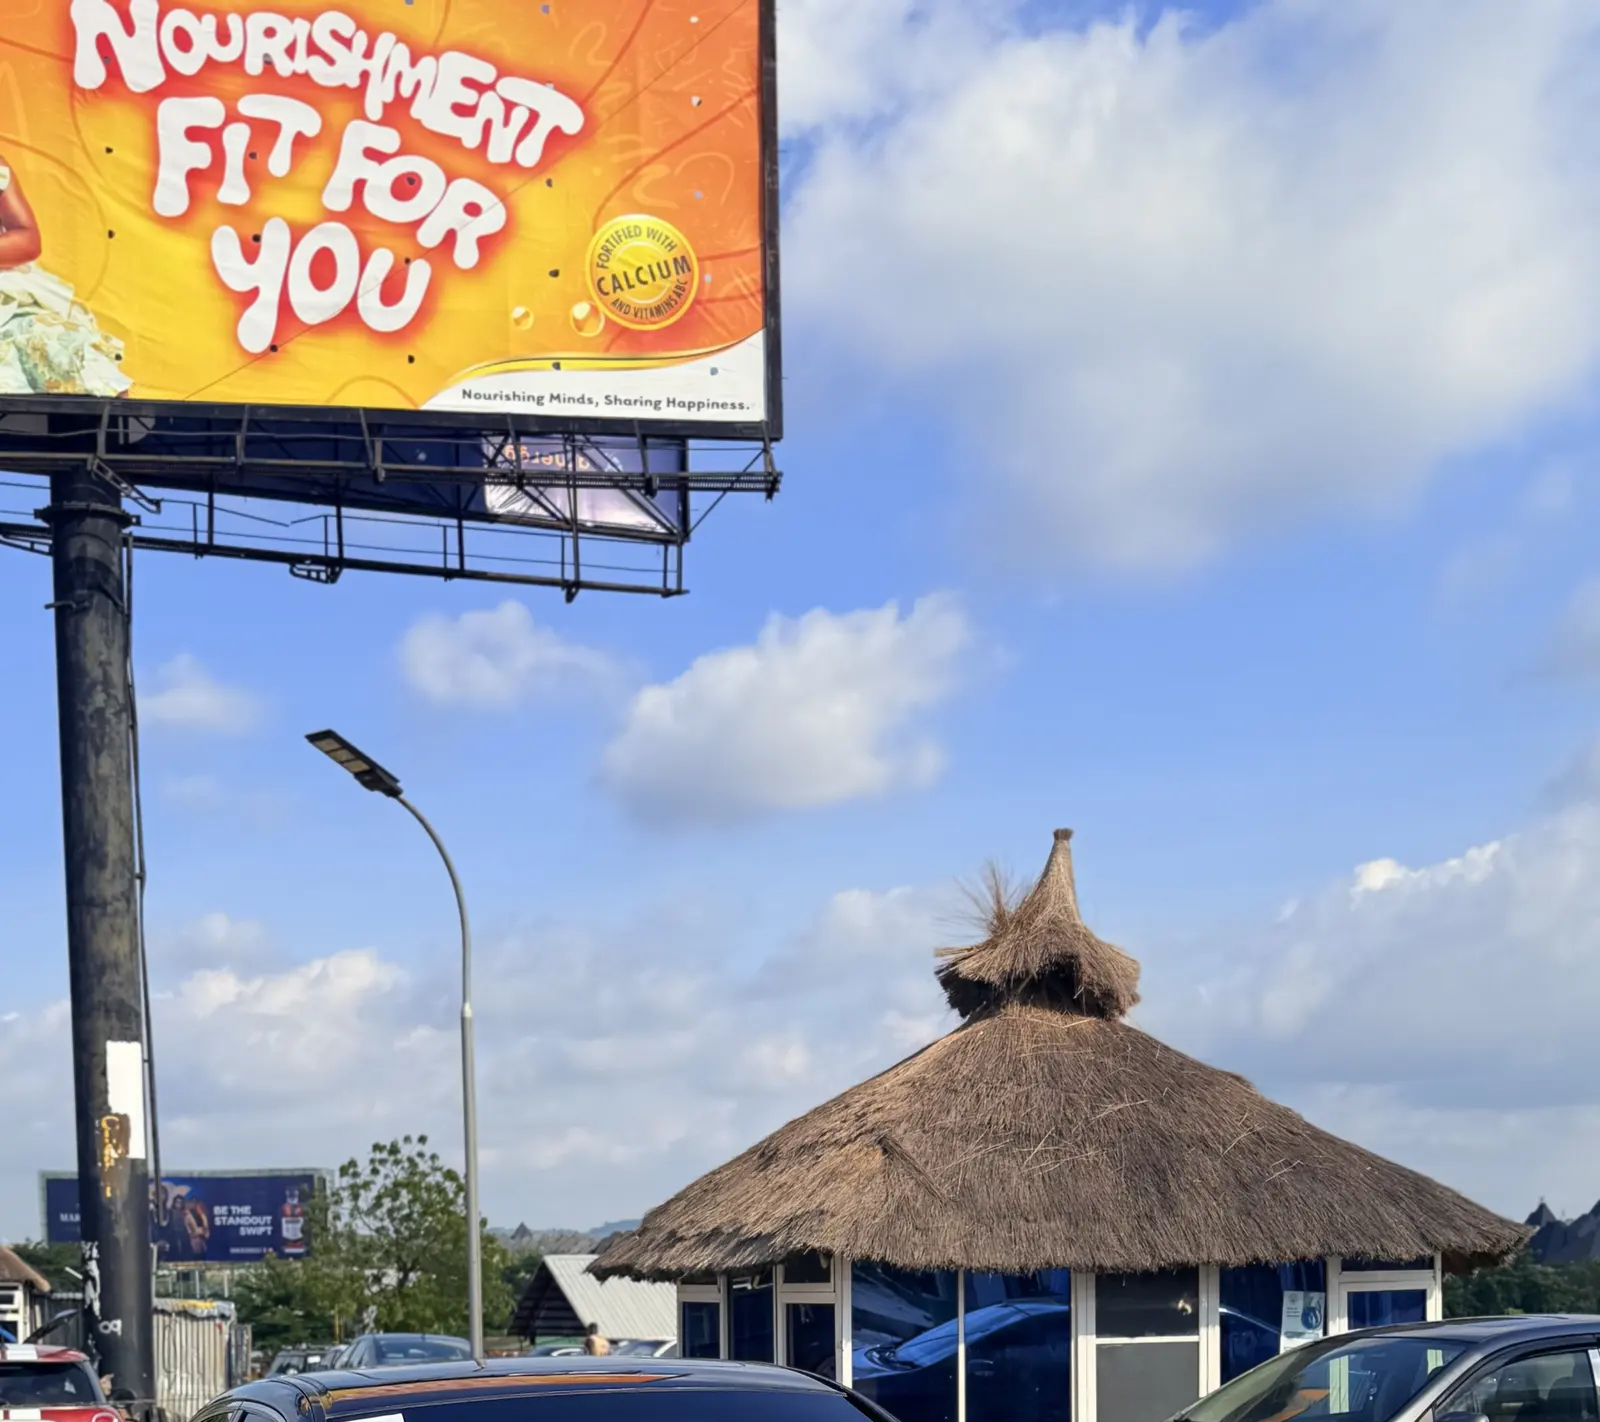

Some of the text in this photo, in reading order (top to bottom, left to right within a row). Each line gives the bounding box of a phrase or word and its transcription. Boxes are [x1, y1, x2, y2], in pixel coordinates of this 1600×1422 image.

[70, 0, 585, 168] NOURISHMENT
[152, 94, 507, 269] FIT FOR
[596, 225, 678, 269] FORTIFIED WITH
[211, 217, 432, 353] YOU
[596, 255, 691, 296] CALCIUM
[611, 298, 631, 315] AND
[633, 295, 678, 319] VITAMINS
[462, 389, 750, 411] Nourishing Minds, Sharing Happiness.
[213, 1205, 251, 1215] BE THE
[214, 1216, 272, 1226] STANDOUT
[239, 1226, 273, 1236] SWIFT
